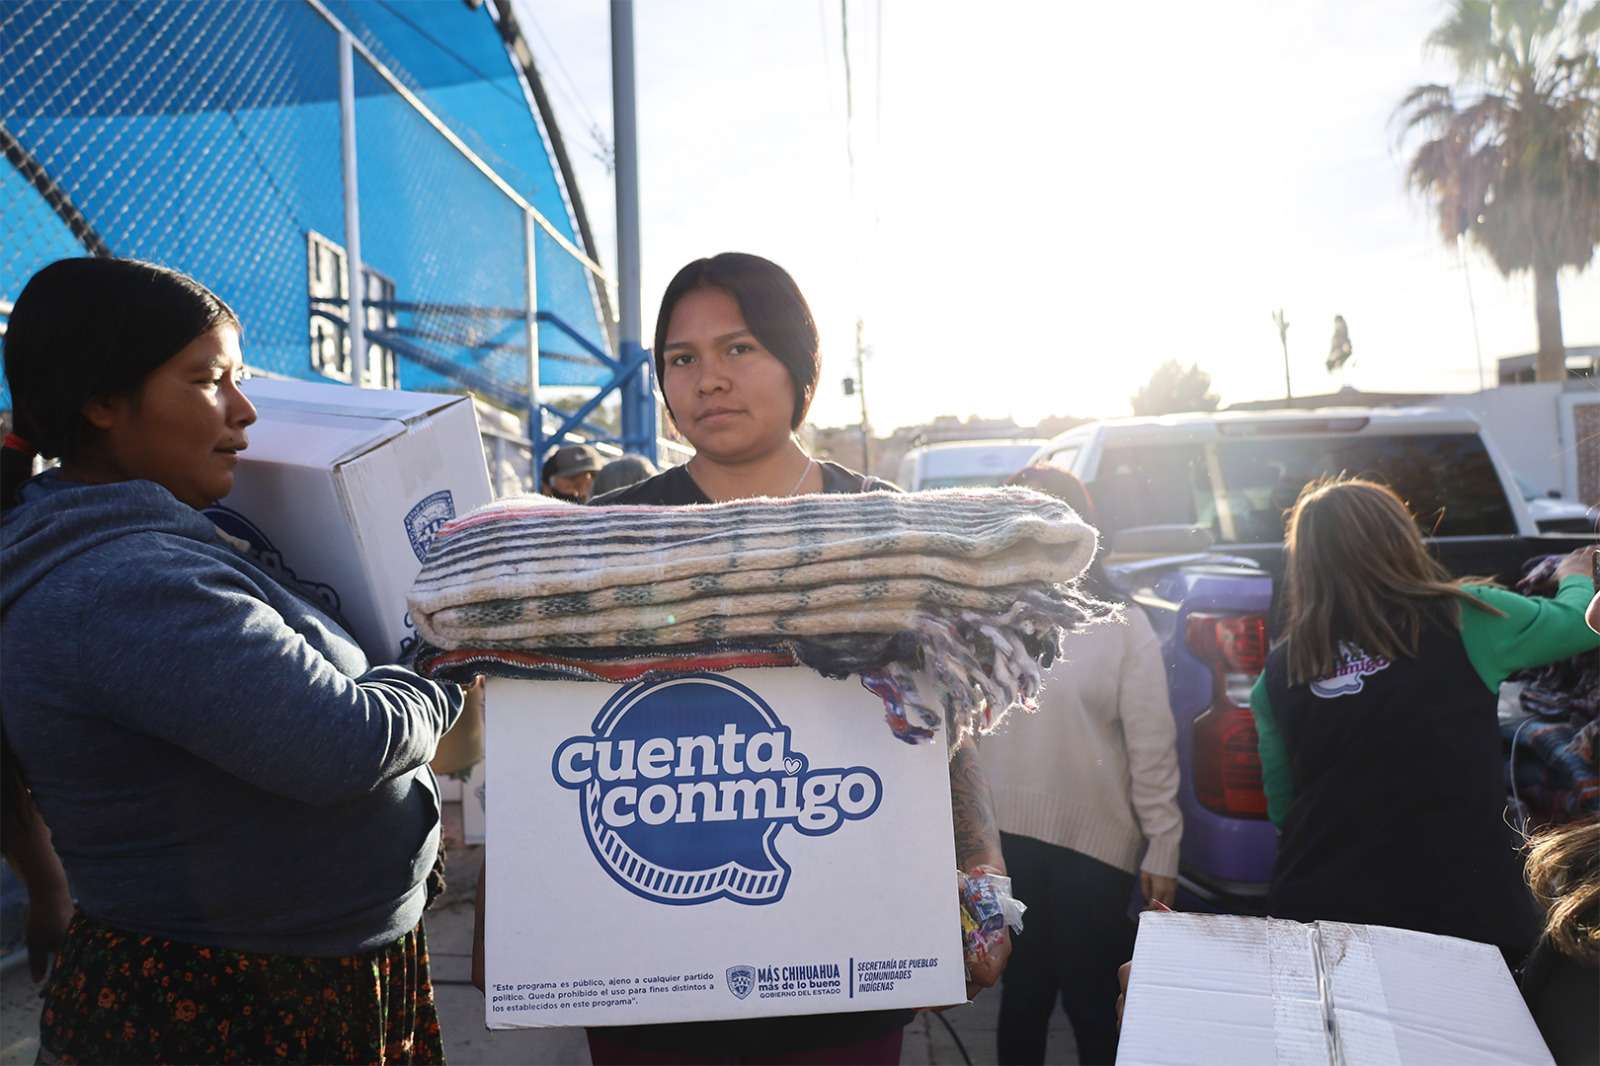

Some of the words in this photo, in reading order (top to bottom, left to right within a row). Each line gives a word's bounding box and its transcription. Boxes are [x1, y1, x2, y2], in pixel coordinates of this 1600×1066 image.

[557, 723, 786, 784] cuenta
[601, 771, 877, 830] conmigo
[857, 959, 897, 971] SECRETARÍA
[898, 959, 908, 969] DE
[908, 958, 938, 968] PUEBLOS
[758, 965, 780, 983] MÁS
[782, 964, 840, 981] CHIHUAHUA
[858, 973, 864, 982] Y
[864, 970, 912, 981] COMUNIDADES
[517, 982, 557, 991] programa
[573, 979, 606, 988] público,
[609, 977, 631, 986] ajeno
[643, 974, 681, 984] cualquier
[684, 972, 714, 982] partido
[759, 981, 780, 991] más
[781, 981, 796, 990] de
[797, 980, 807, 989] lo
[809, 979, 841, 988] bueno
[858, 981, 894, 992] INDÍGENAS
[528, 992, 555, 1000] Queda
[558, 989, 599, 999] prohibido
[600, 988, 608, 996] el
[628, 987, 647, 996] para
[649, 985, 669, 993] fines
[671, 983, 707, 992] distintos
[506, 1002, 558, 1012] establecidos
[572, 1000, 590, 1008] este
